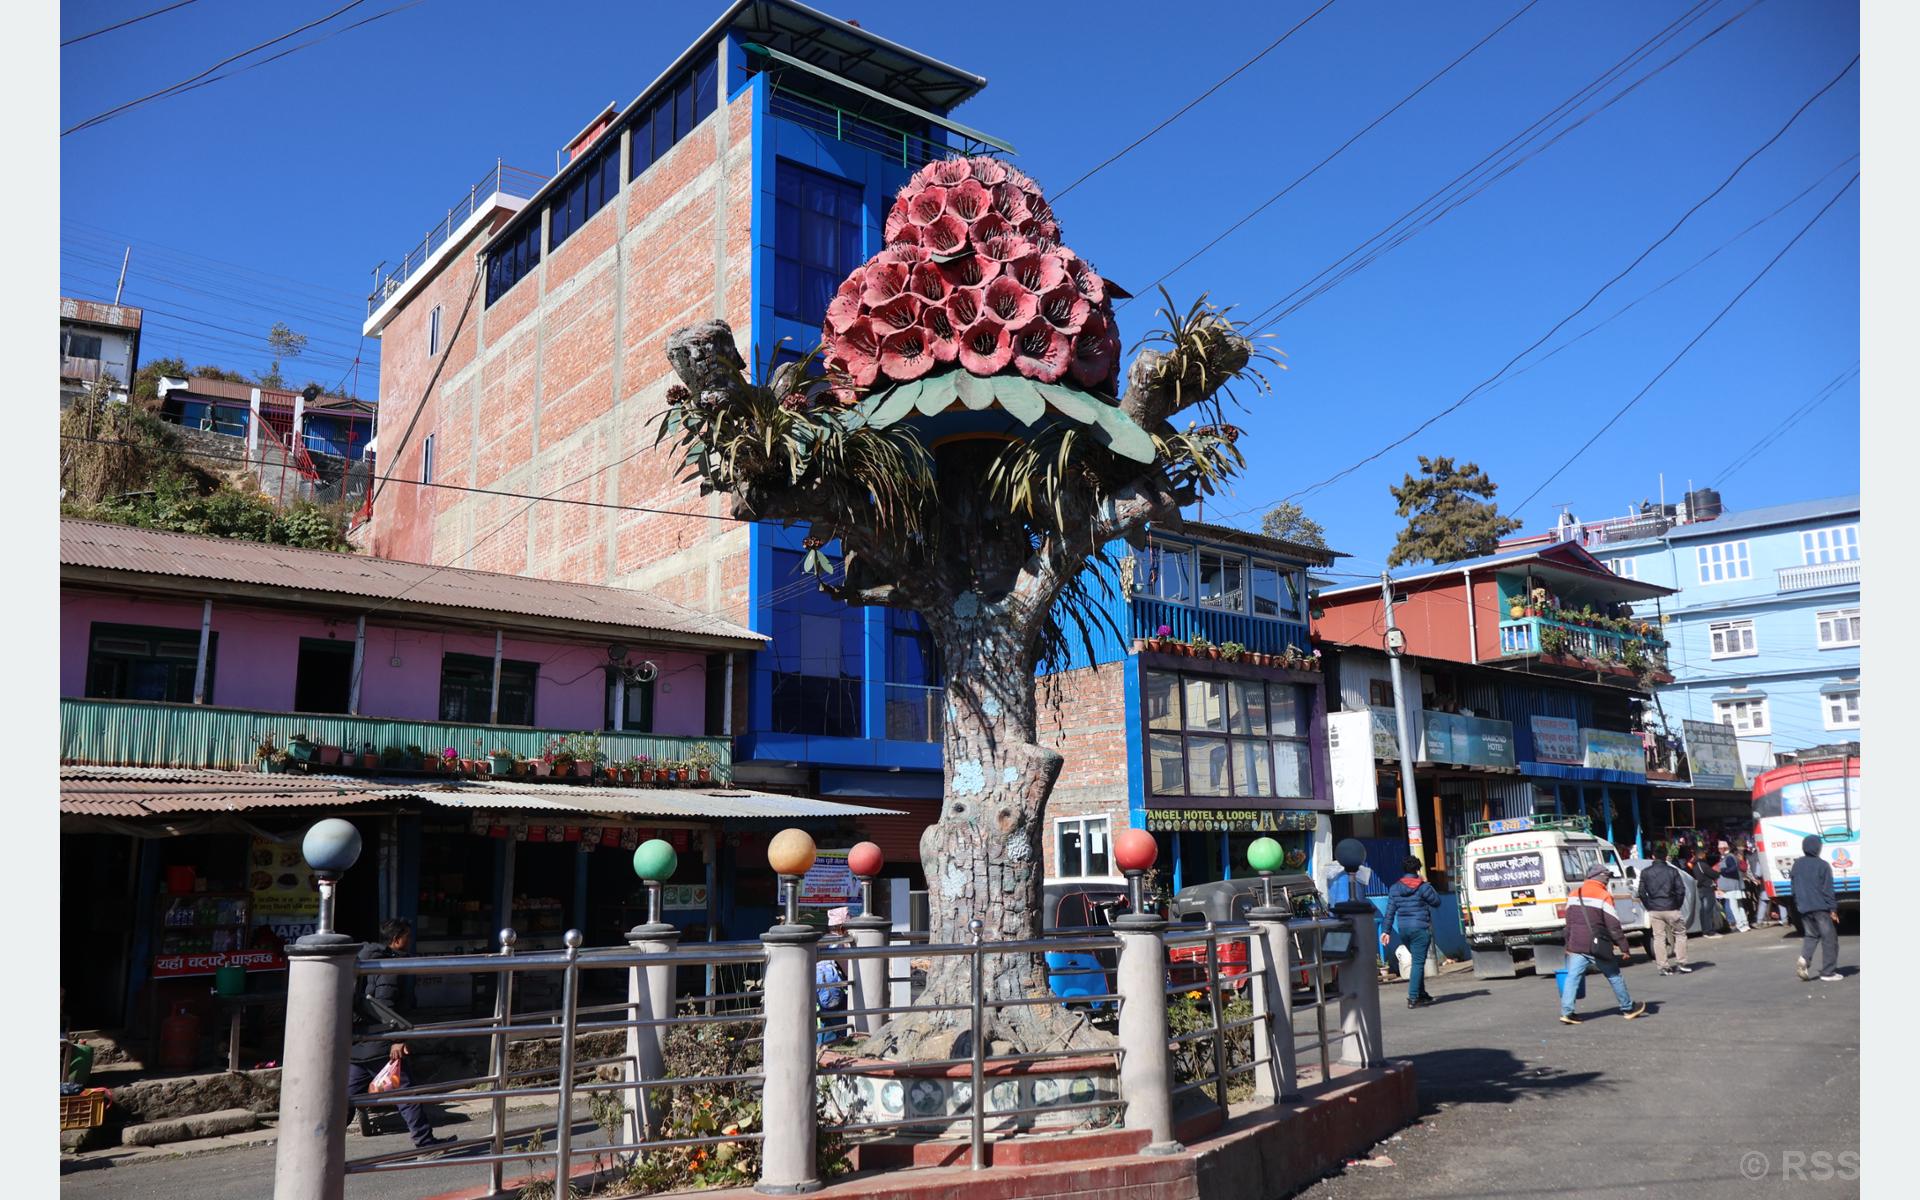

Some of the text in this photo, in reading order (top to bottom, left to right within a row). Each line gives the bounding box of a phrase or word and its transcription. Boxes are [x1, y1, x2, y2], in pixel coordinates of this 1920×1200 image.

[1487, 743, 1504, 751] HOTEL
[1147, 810, 1258, 820] ANGEL HOTEL & LODGE
